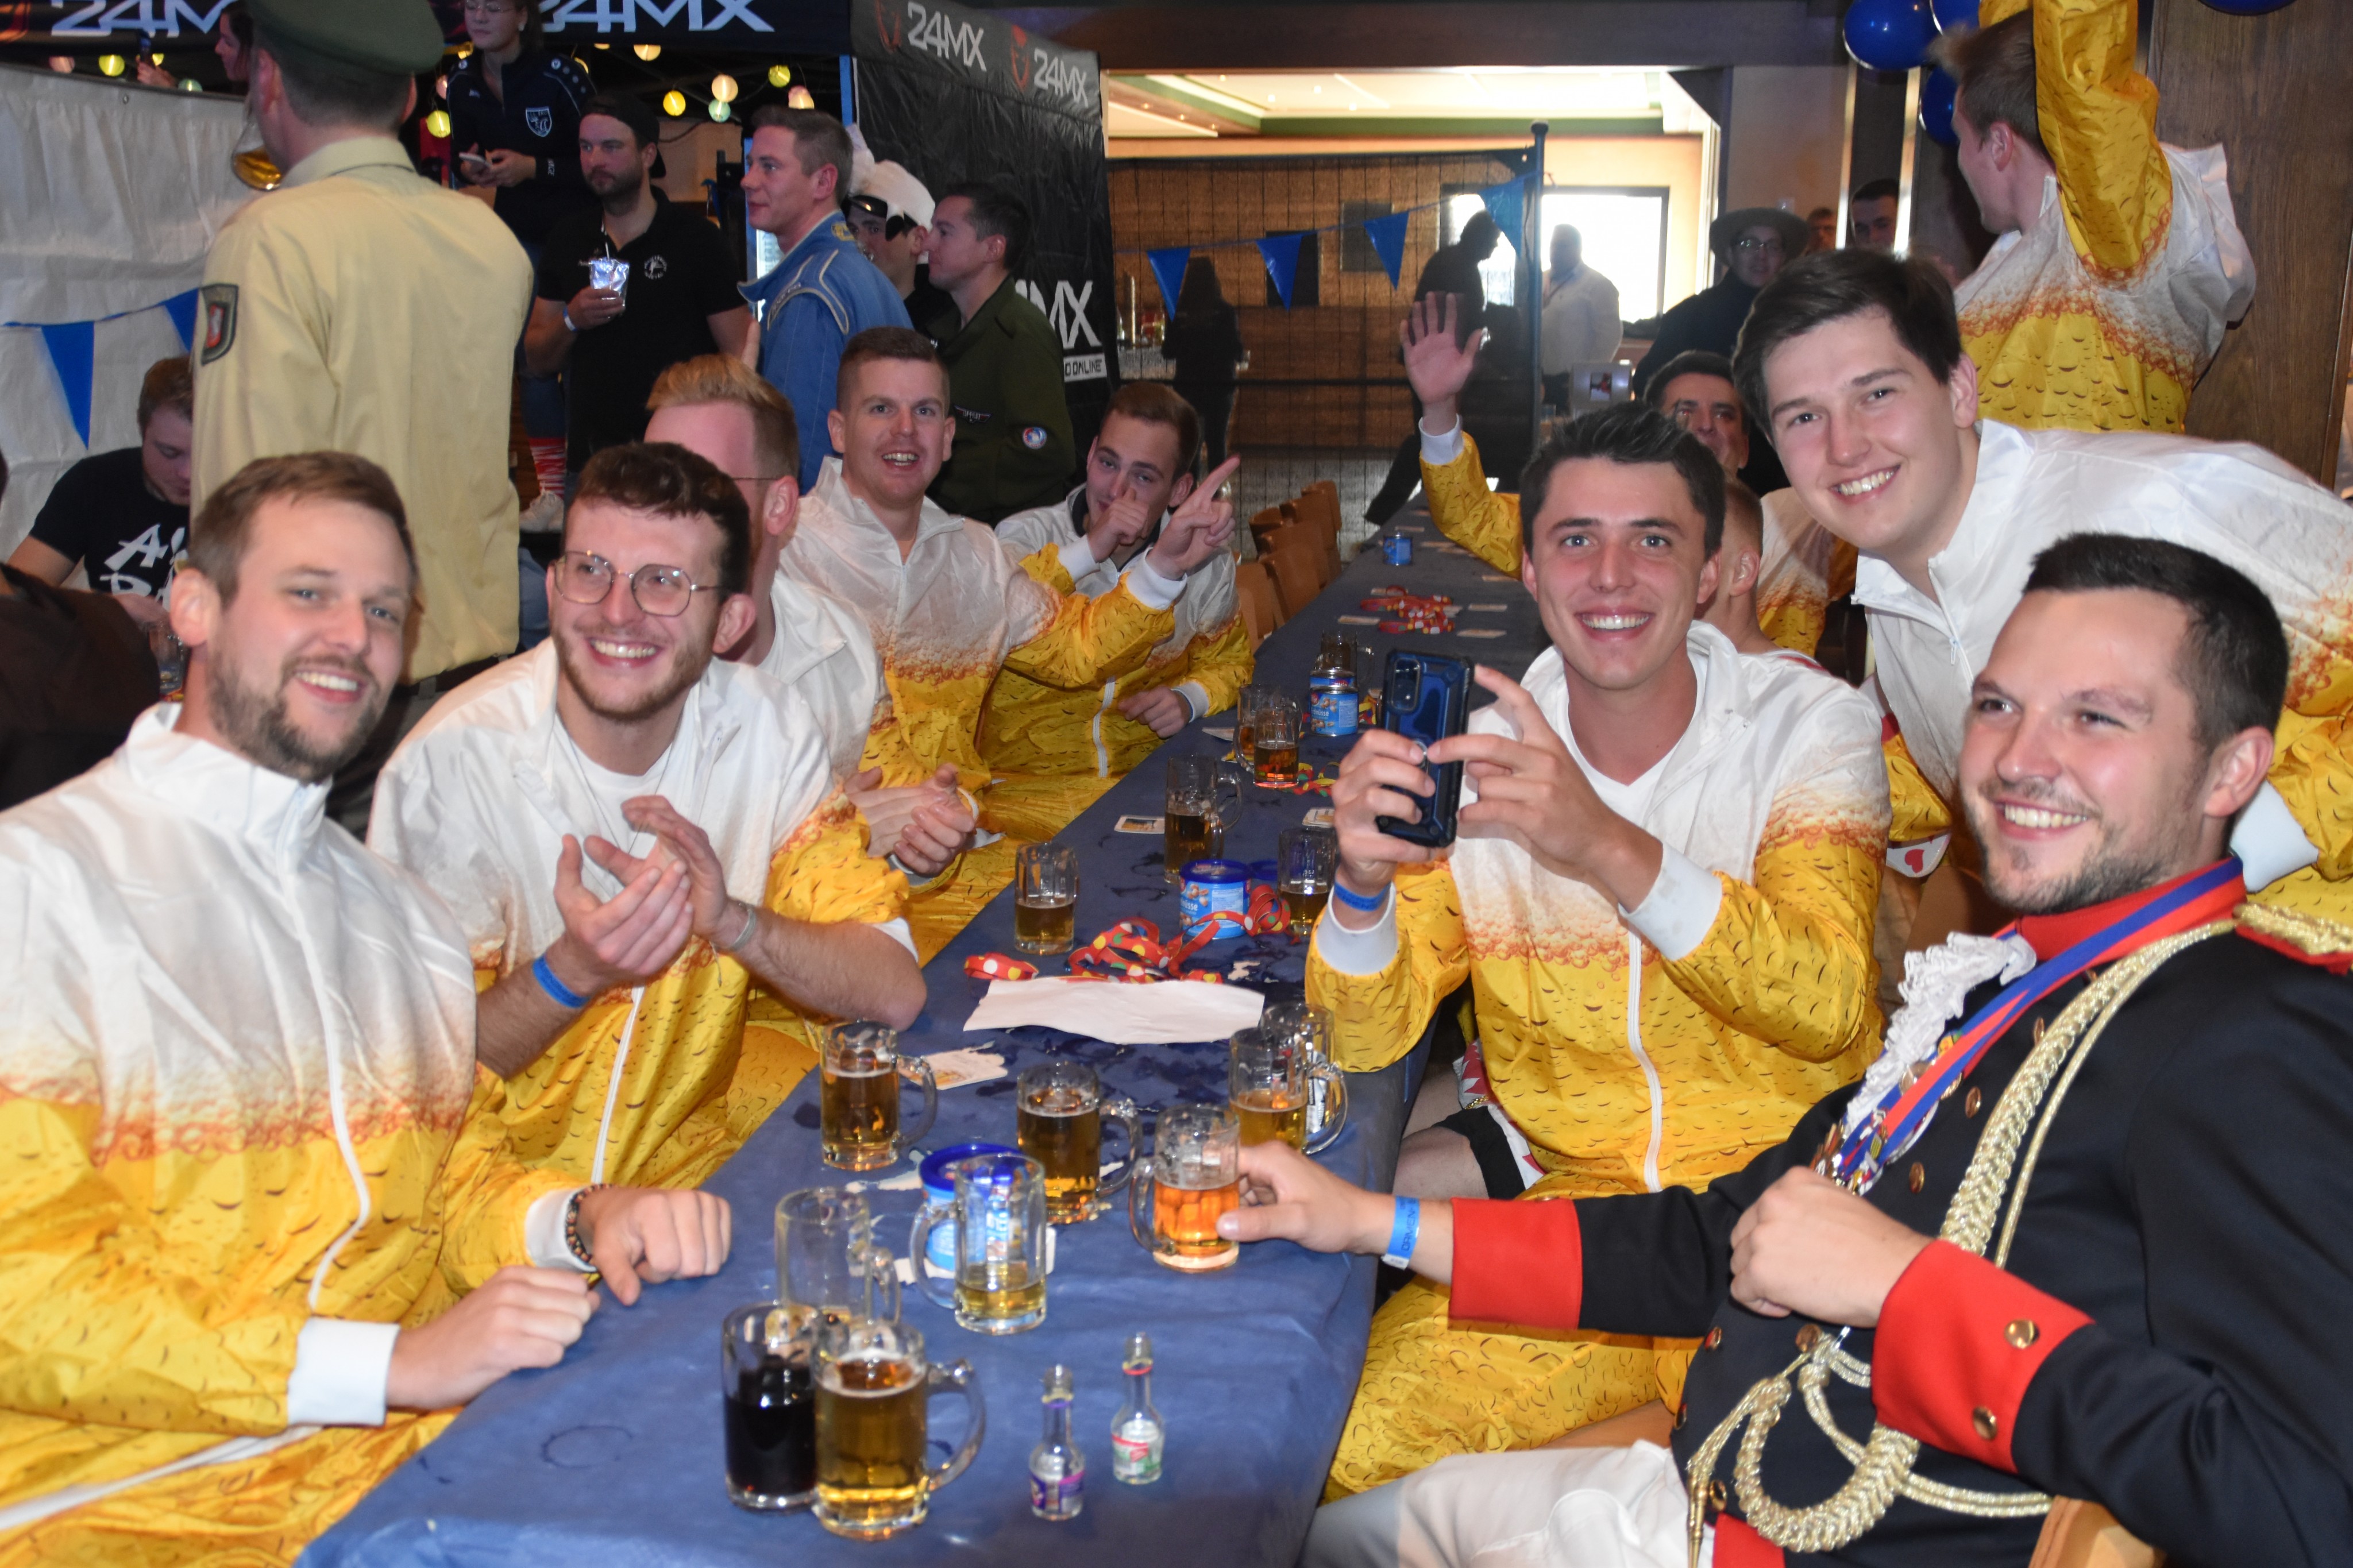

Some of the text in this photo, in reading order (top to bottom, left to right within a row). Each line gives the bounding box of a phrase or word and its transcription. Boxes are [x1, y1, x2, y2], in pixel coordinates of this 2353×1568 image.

[51, 0, 232, 38] 24M
[907, 1, 987, 72] 24MX
[1034, 48, 1089, 108] 24MX
[1015, 279, 1102, 349] MX
[1073, 359, 1102, 375] ONLINE
